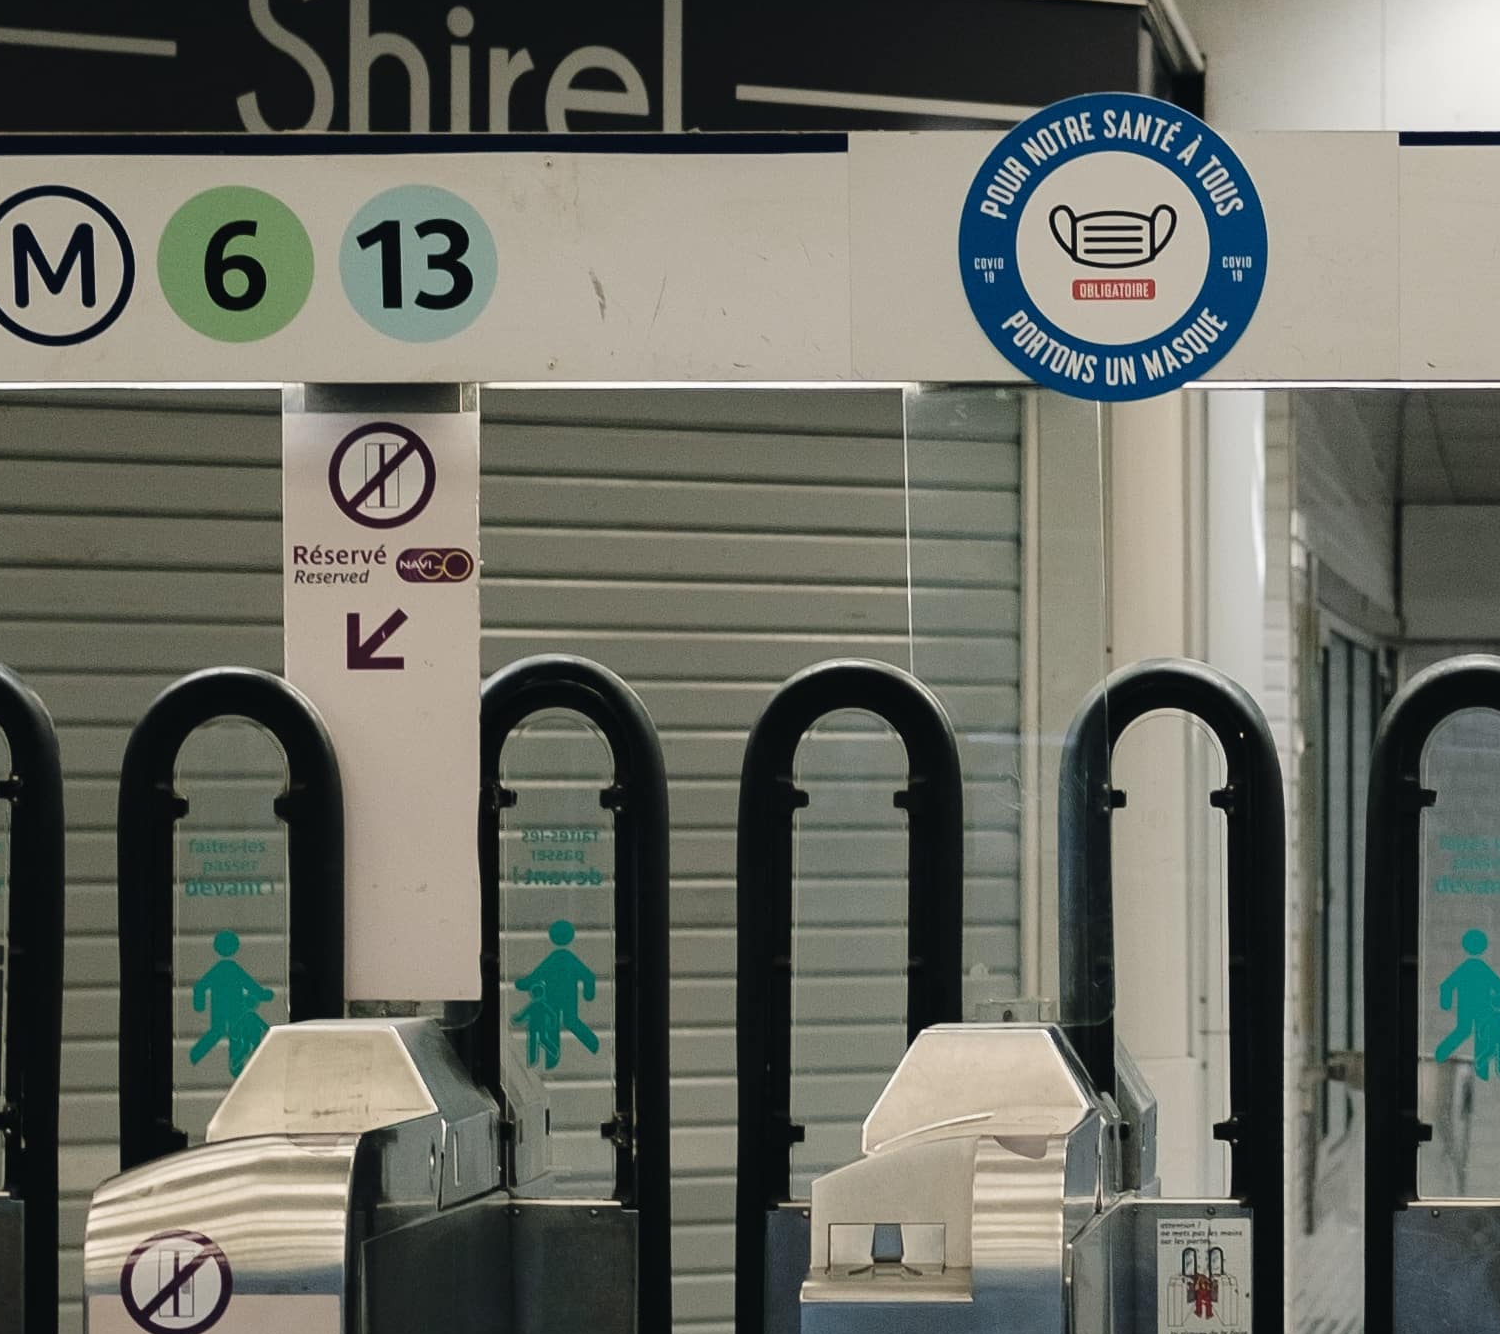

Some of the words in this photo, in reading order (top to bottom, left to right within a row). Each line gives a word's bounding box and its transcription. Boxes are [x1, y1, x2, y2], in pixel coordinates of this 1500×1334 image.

[980, 156, 1031, 220] POUR
[1021, 112, 1096, 166] NOTRE
[1103, 109, 1183, 153] SANTÉ
[1176, 134, 1203, 167] À
[1195, 154, 1244, 217] TOUS
[12, 222, 97, 309] M
[202, 219, 268, 313] 6
[356, 215, 477, 312] 13
[974, 257, 1004, 270] COVID
[1222, 256, 1252, 269] COVID
[984, 271, 995, 284] 19
[1232, 270, 1243, 282] 19
[1079, 283, 1149, 298] OBLIGATOIRE
[1001, 309, 1098, 384] PORTONS
[1105, 357, 1137, 386] UN
[1141, 306, 1229, 381] MASQUE
[293, 544, 387, 565] Réservé
[294, 570, 369, 584] Reserved
